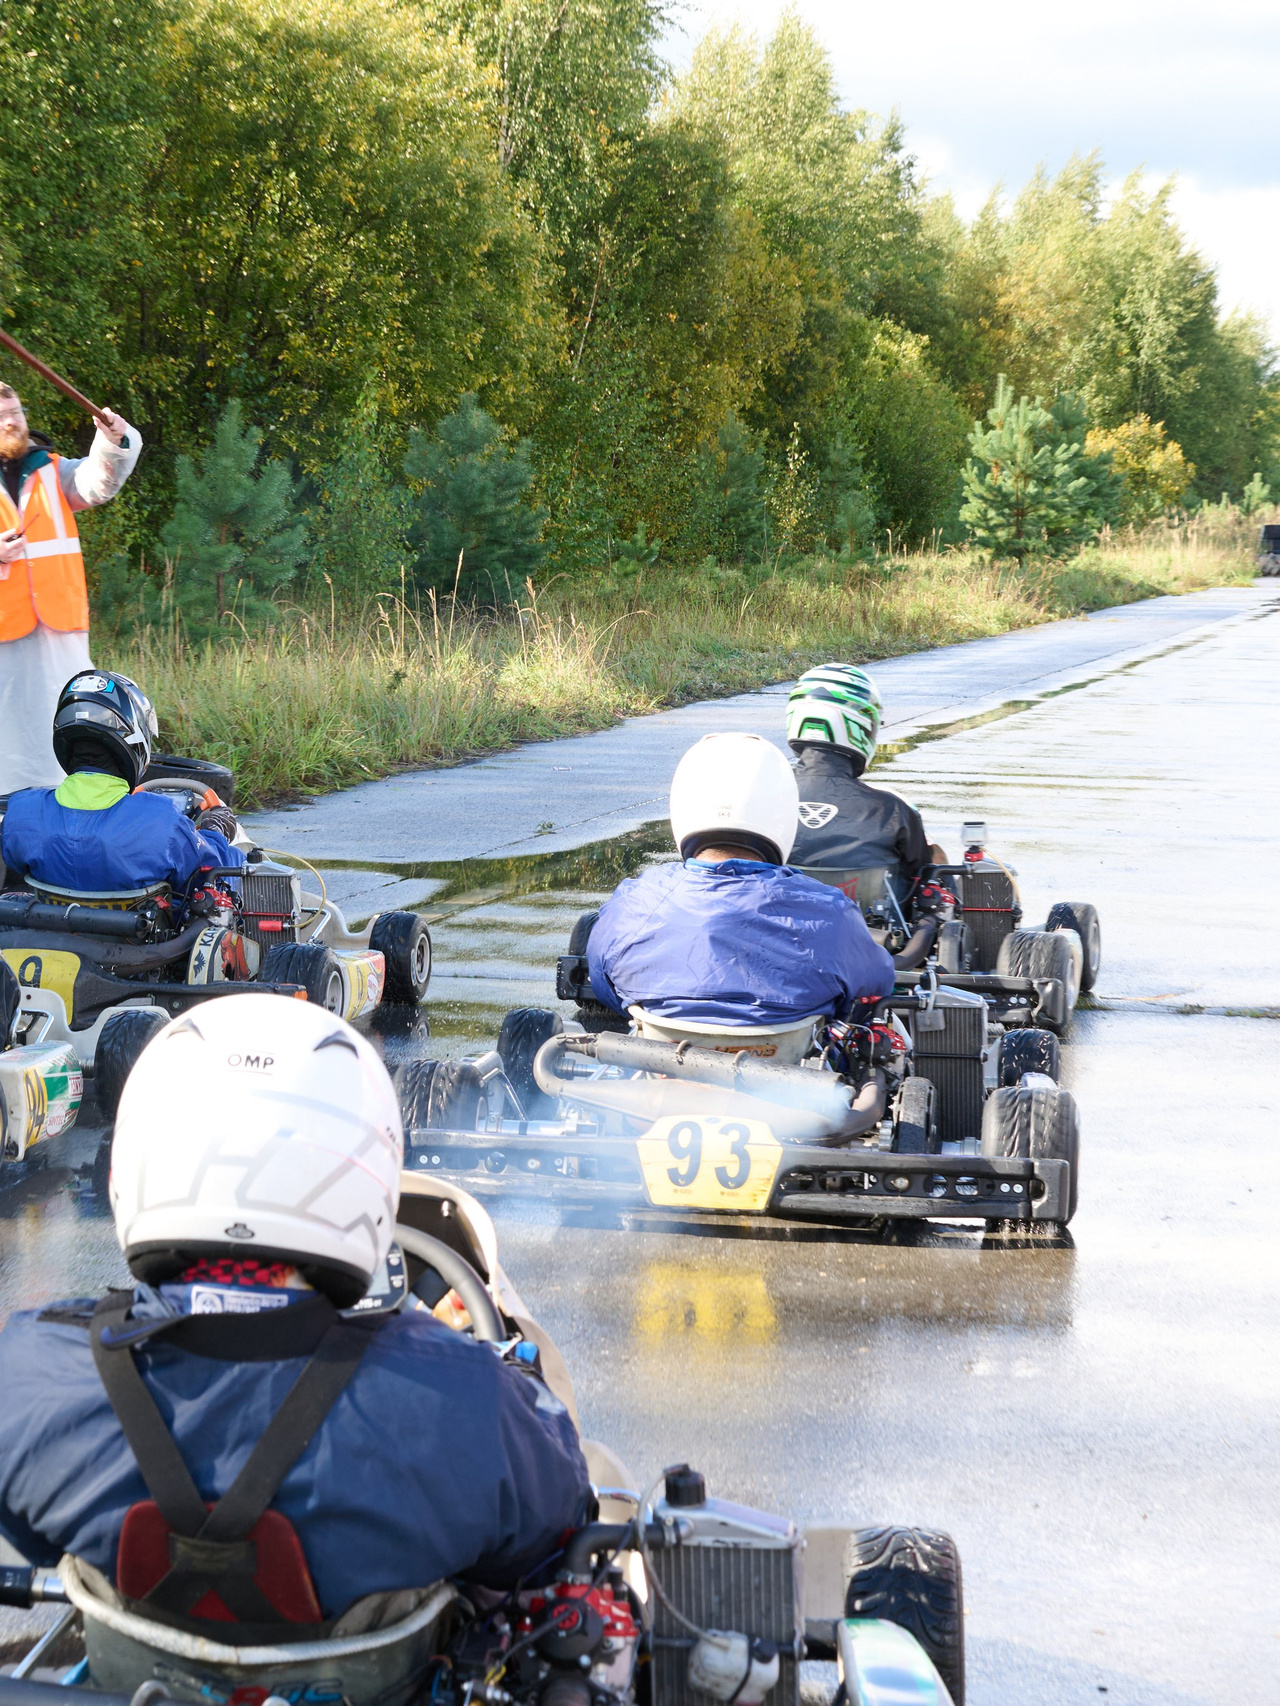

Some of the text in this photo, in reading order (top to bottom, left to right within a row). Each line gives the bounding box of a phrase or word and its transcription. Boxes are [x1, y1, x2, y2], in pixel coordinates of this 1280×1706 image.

[227, 1053, 274, 1069] OMP
[24, 1068, 46, 1144] 94
[666, 1120, 751, 1190] 93
